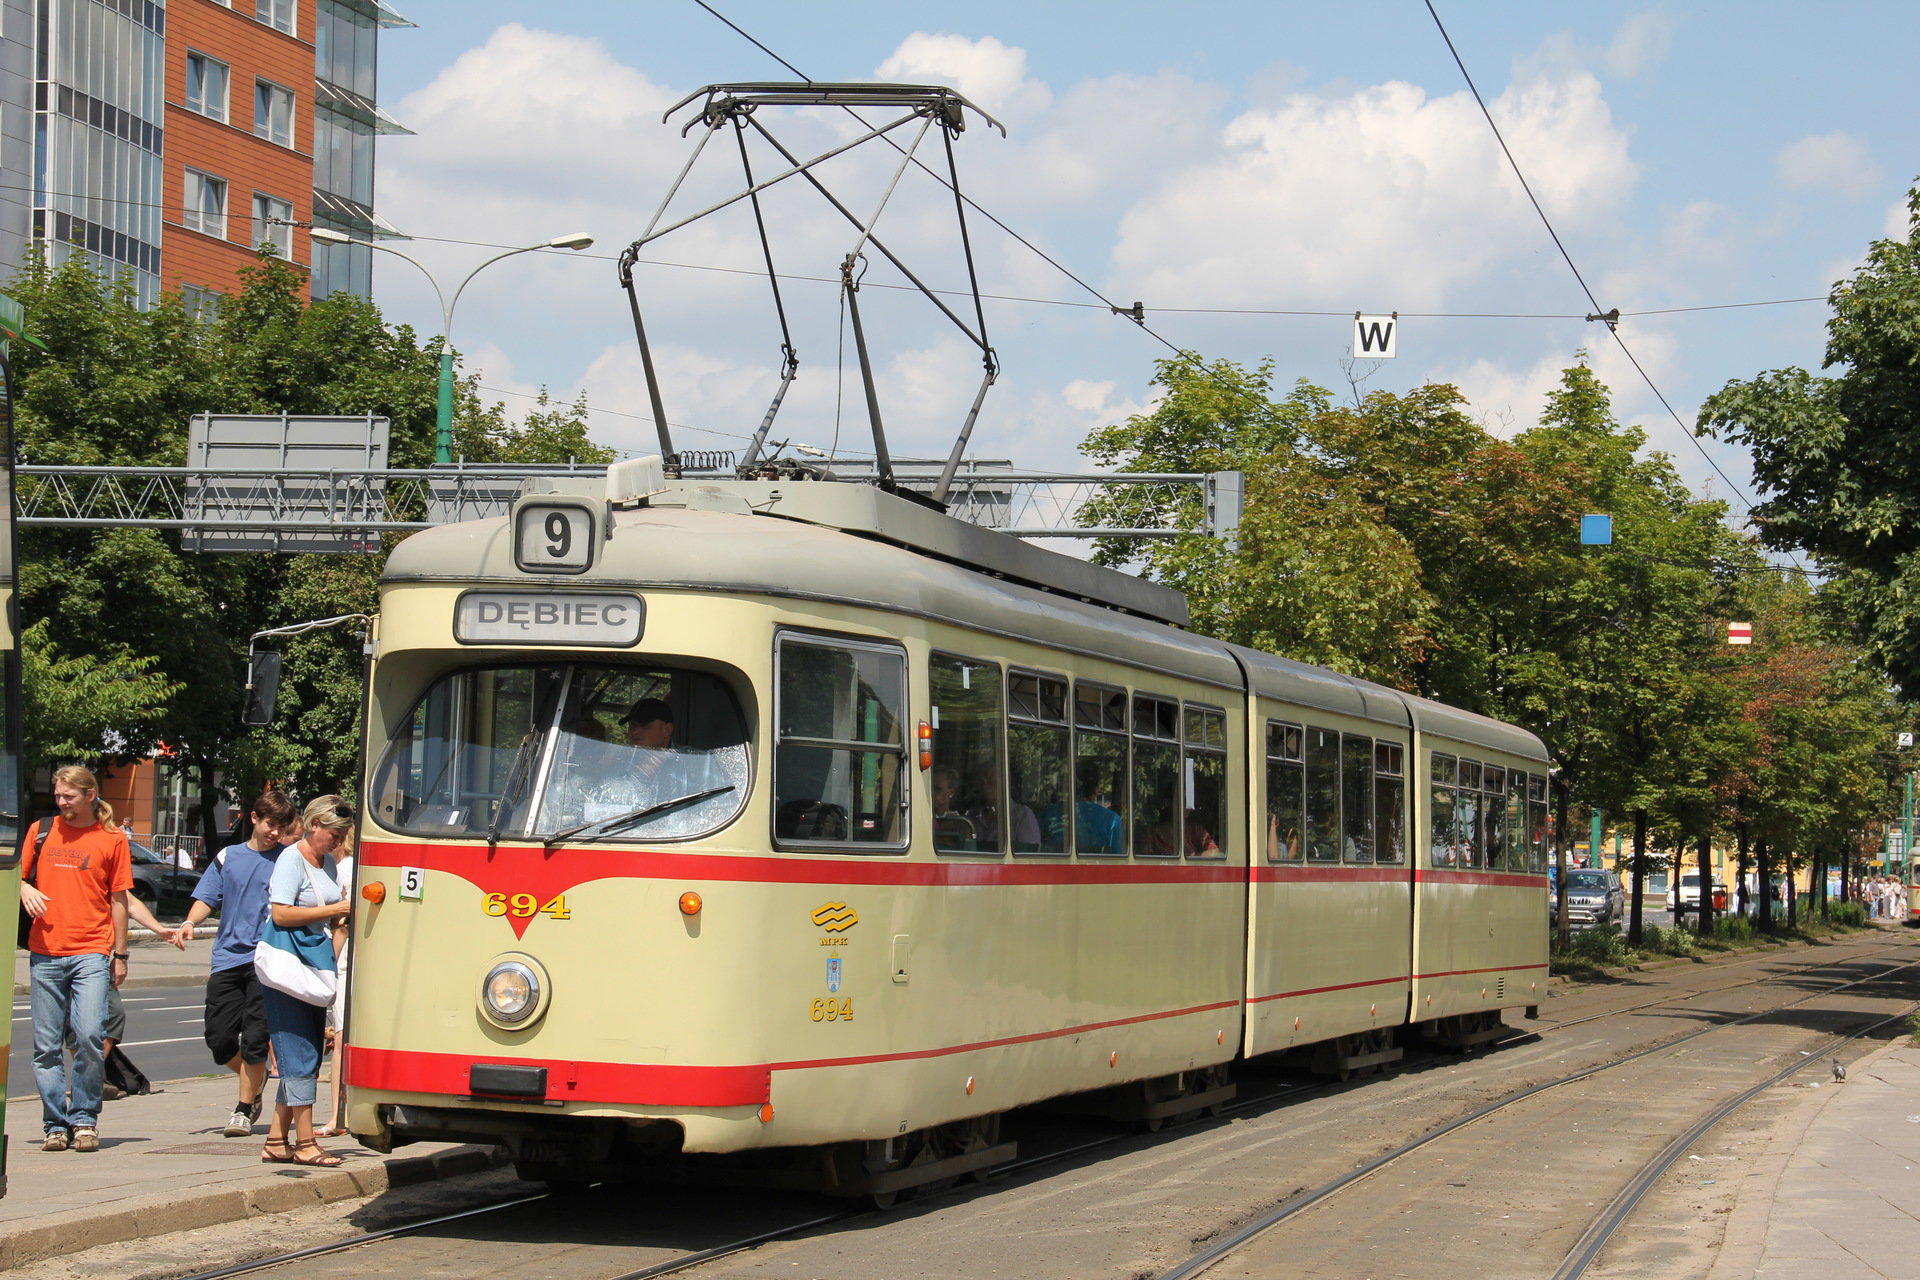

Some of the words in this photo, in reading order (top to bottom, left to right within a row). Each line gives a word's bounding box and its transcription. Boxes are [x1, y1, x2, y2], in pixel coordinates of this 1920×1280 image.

[1358, 322, 1393, 352] W
[545, 512, 572, 558] 9
[478, 601, 628, 630] DĘBIEC
[406, 871, 418, 891] 5
[481, 893, 571, 920] 694
[820, 937, 848, 946] MPK
[810, 997, 853, 1022] 694
